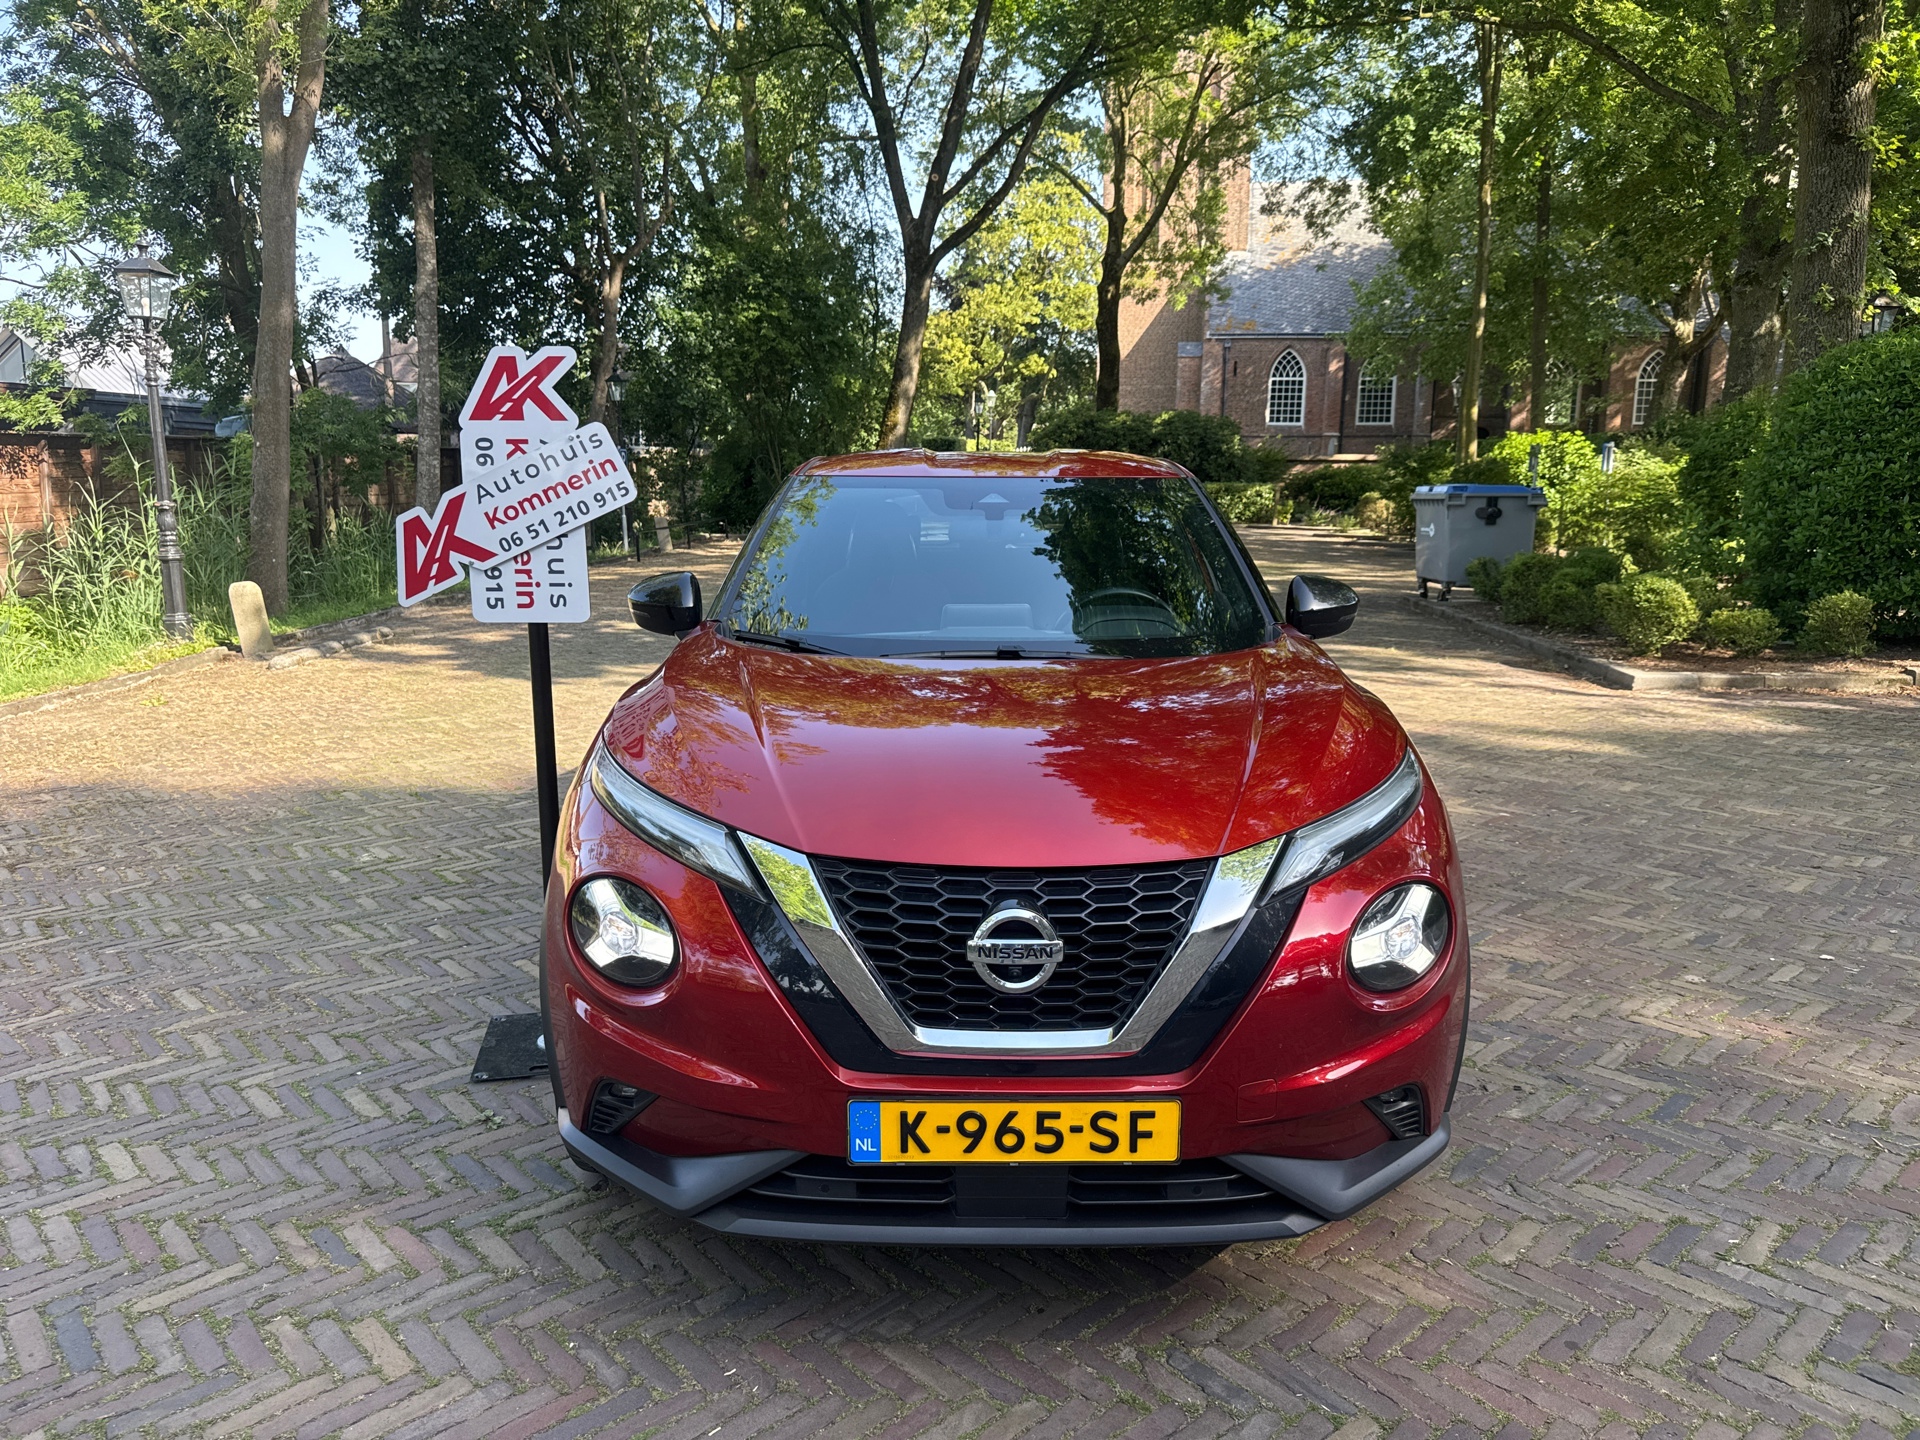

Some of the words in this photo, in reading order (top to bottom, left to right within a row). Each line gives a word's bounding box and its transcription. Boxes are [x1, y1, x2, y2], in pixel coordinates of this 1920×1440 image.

[475, 437, 494, 467] 06
[476, 433, 603, 504] Autohuis
[484, 458, 618, 530] Kommerin
[499, 531, 524, 553] 06
[526, 518, 550, 540] 51
[553, 500, 590, 527] 210
[593, 480, 630, 508] 915
[484, 566, 505, 609] 915
[977, 946, 1053, 960] NISSAN
[855, 1138, 877, 1151] NL
[899, 1110, 1156, 1154] K-965-SF
